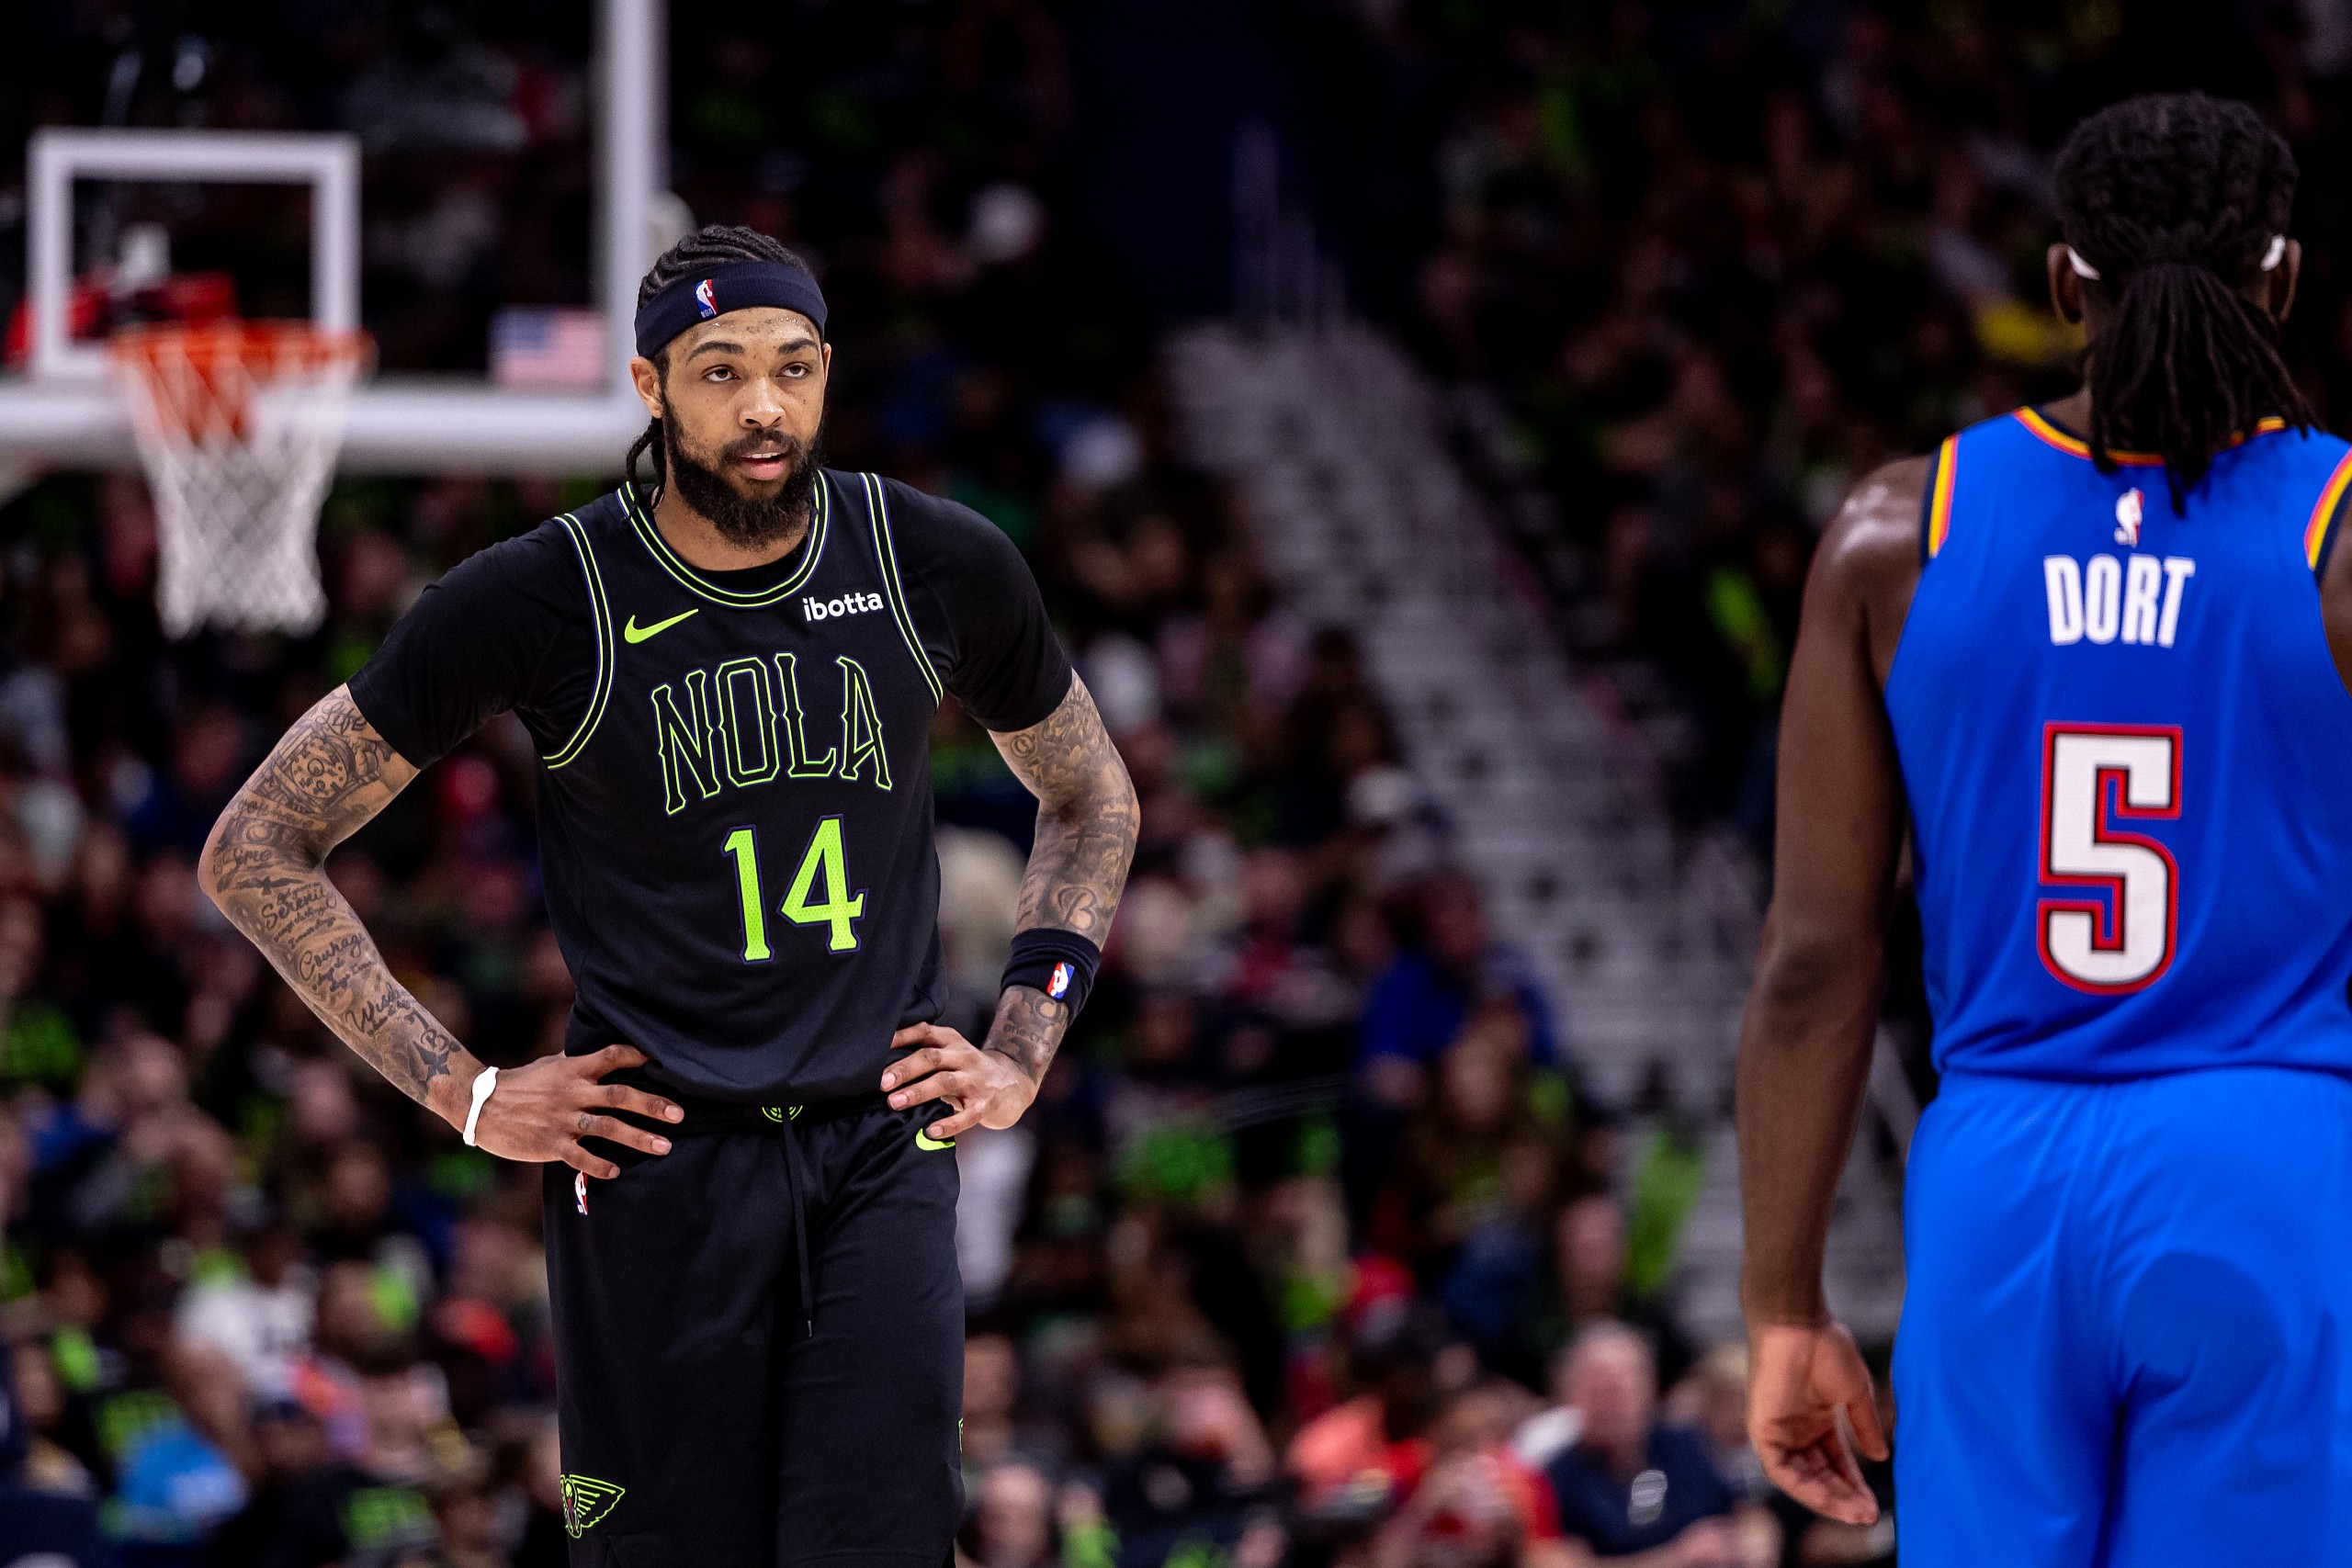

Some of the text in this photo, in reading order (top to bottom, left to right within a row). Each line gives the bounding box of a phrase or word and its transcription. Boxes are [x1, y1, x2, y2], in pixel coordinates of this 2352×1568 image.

[802, 592, 885, 622] ibotta
[2042, 552, 2196, 649] DORT
[650, 651, 892, 816] NOLA
[720, 816, 867, 963] 14
[2037, 722, 2182, 996] 5
